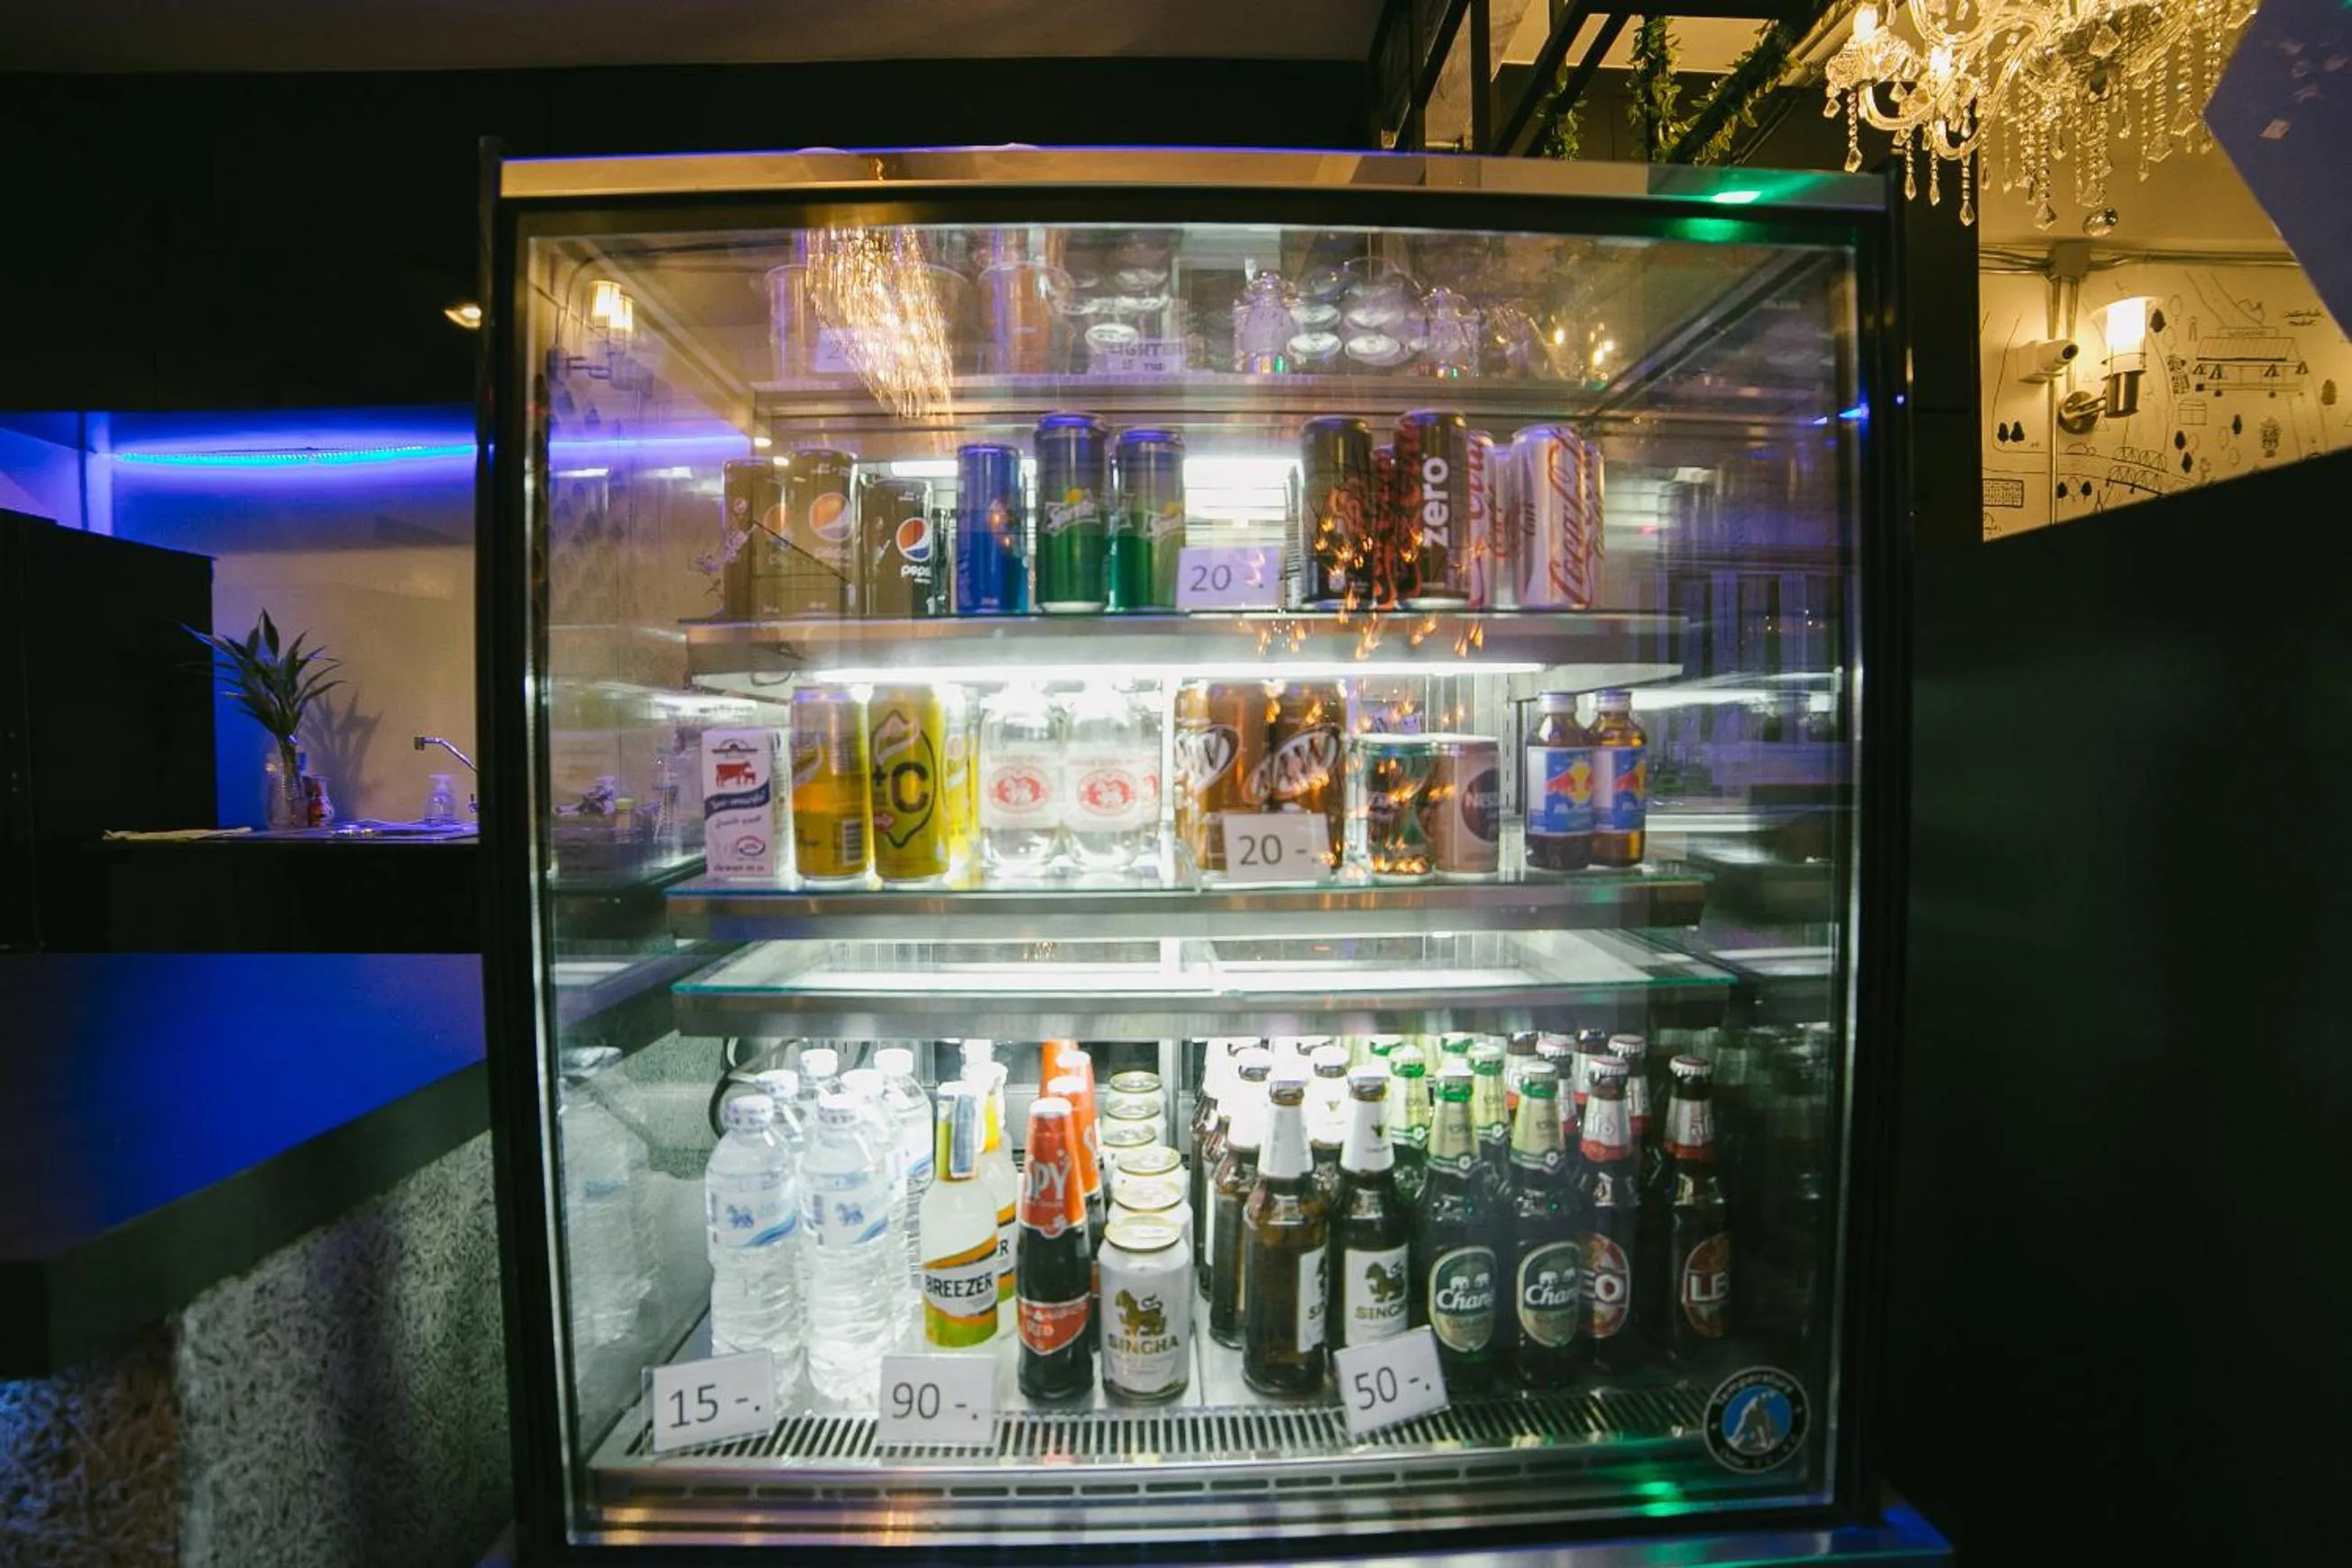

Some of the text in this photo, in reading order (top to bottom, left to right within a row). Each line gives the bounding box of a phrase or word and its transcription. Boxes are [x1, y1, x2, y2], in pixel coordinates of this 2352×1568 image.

[1422, 456, 1449, 548] zero
[1190, 564, 1232, 592] 20
[1237, 834, 1282, 867] 20
[925, 1271, 993, 1298] BREEZER
[1689, 1270, 1730, 1302] LE
[1107, 1333, 1180, 1354] SINGHA
[892, 1382, 941, 1420] 90
[1355, 1366, 1397, 1409] 50
[668, 1383, 719, 1428] 15
